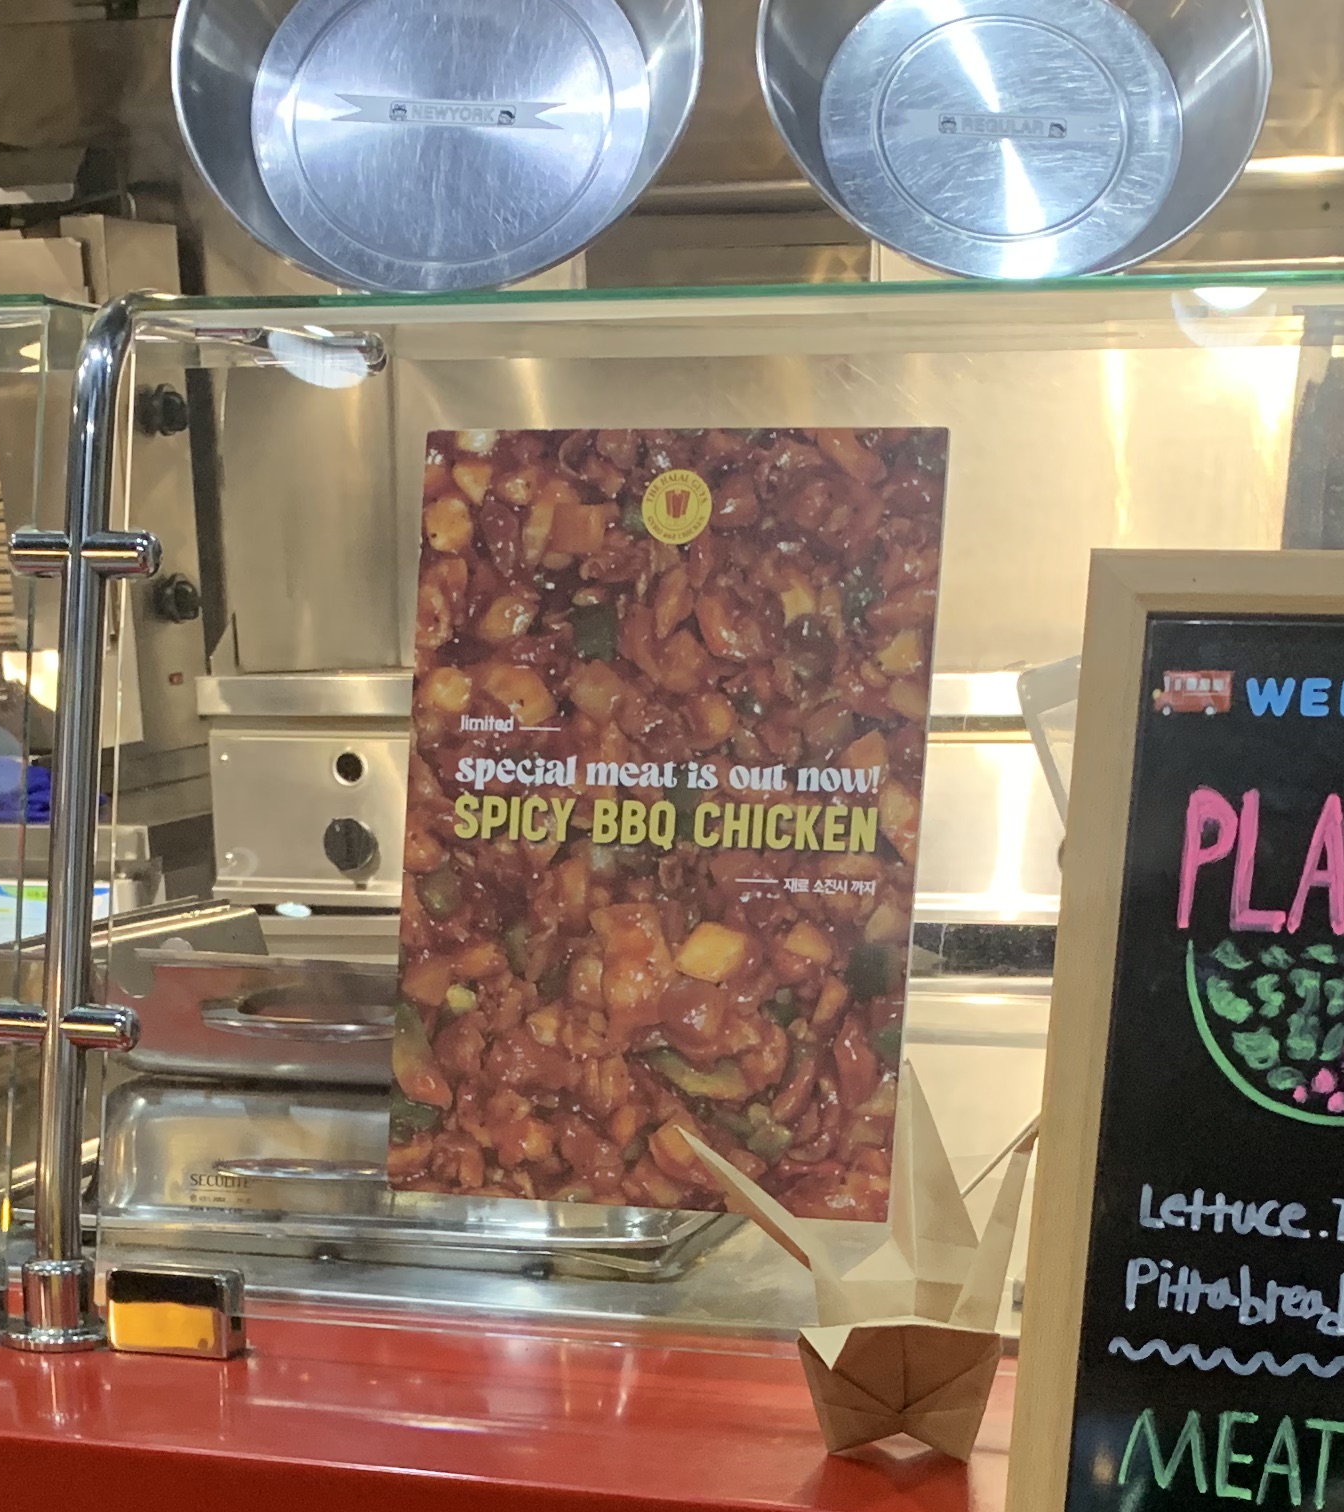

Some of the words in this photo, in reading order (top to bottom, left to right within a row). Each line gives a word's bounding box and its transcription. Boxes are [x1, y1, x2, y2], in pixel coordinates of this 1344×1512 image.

[460, 714, 514, 732] limited
[455, 755, 578, 790] special
[585, 761, 678, 789] meat
[687, 760, 719, 790] is
[729, 763, 787, 791] out
[796, 764, 882, 795] now!
[454, 793, 576, 842] SPICY
[592, 799, 677, 851] BBQ
[693, 802, 880, 853] CHICKEN
[782, 877, 810, 894] 재료
[813, 878, 848, 896] 소진시
[851, 879, 877, 896] 까지
